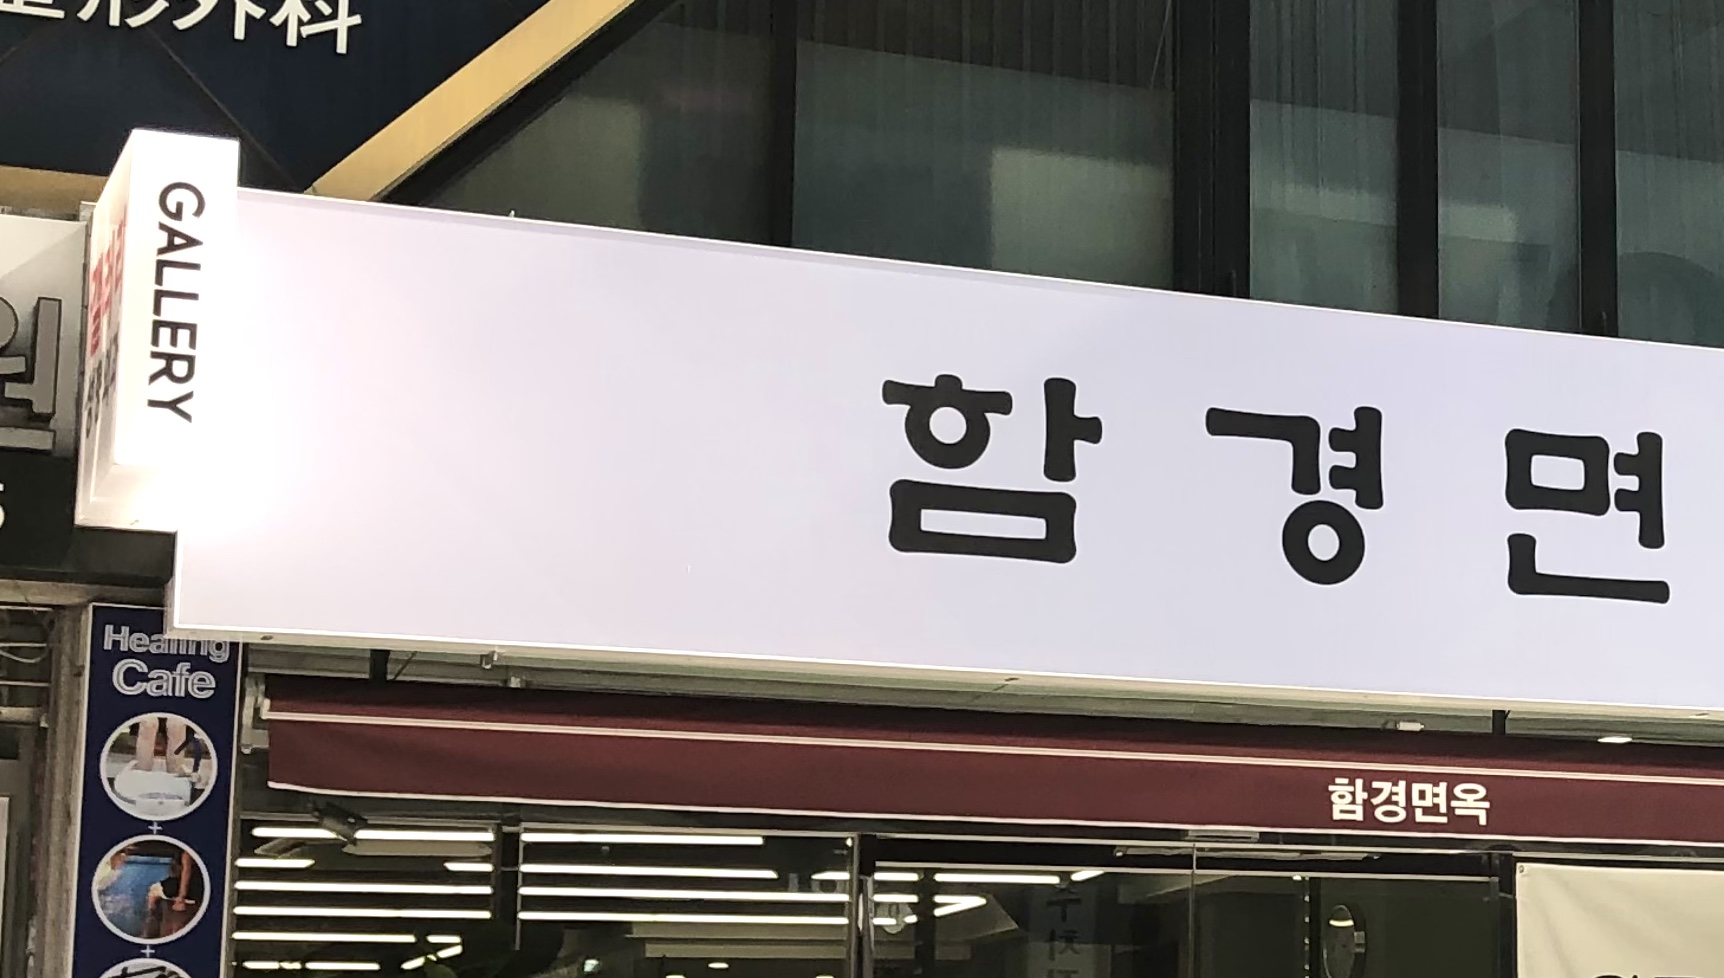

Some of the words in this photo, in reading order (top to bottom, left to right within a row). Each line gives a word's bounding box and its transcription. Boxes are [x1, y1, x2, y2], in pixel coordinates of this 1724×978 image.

[148, 182, 206, 423] GALLERY
[112, 658, 216, 699] Cafe
[1328, 778, 1491, 826] 함경면옥
